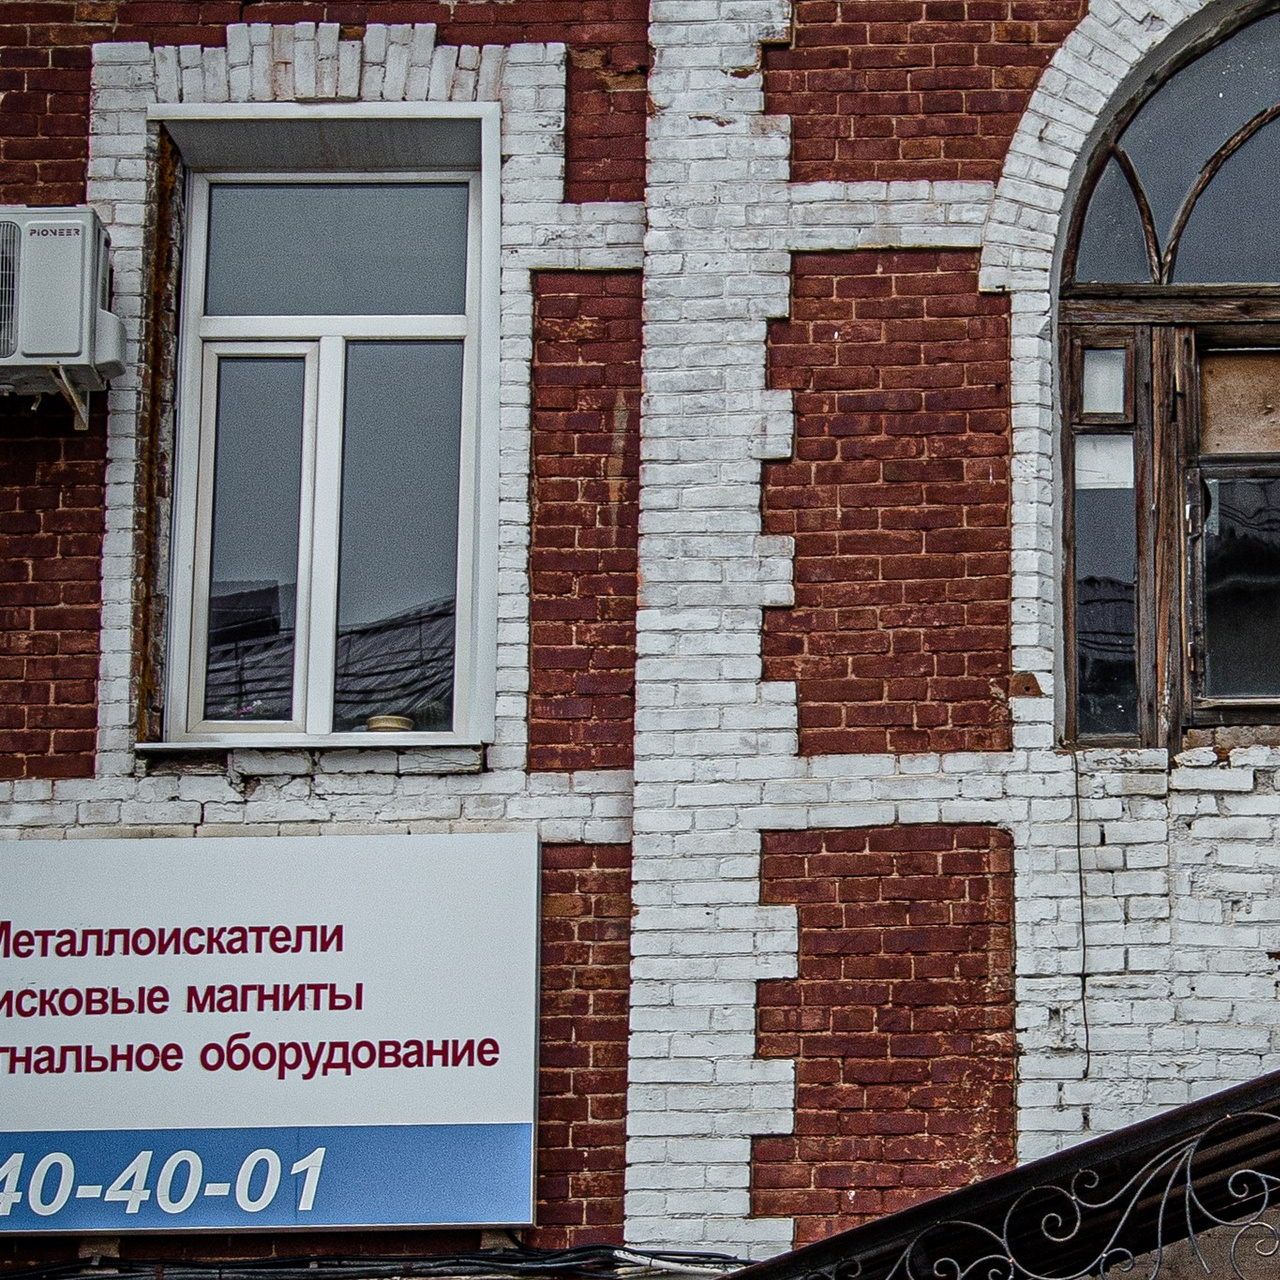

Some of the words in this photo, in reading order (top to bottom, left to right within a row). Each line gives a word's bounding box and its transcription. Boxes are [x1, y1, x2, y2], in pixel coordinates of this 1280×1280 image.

[186, 981, 364, 1014] магниты
[200, 1032, 500, 1080] оборудование
[0, 1147, 326, 1216] 40-40-01
